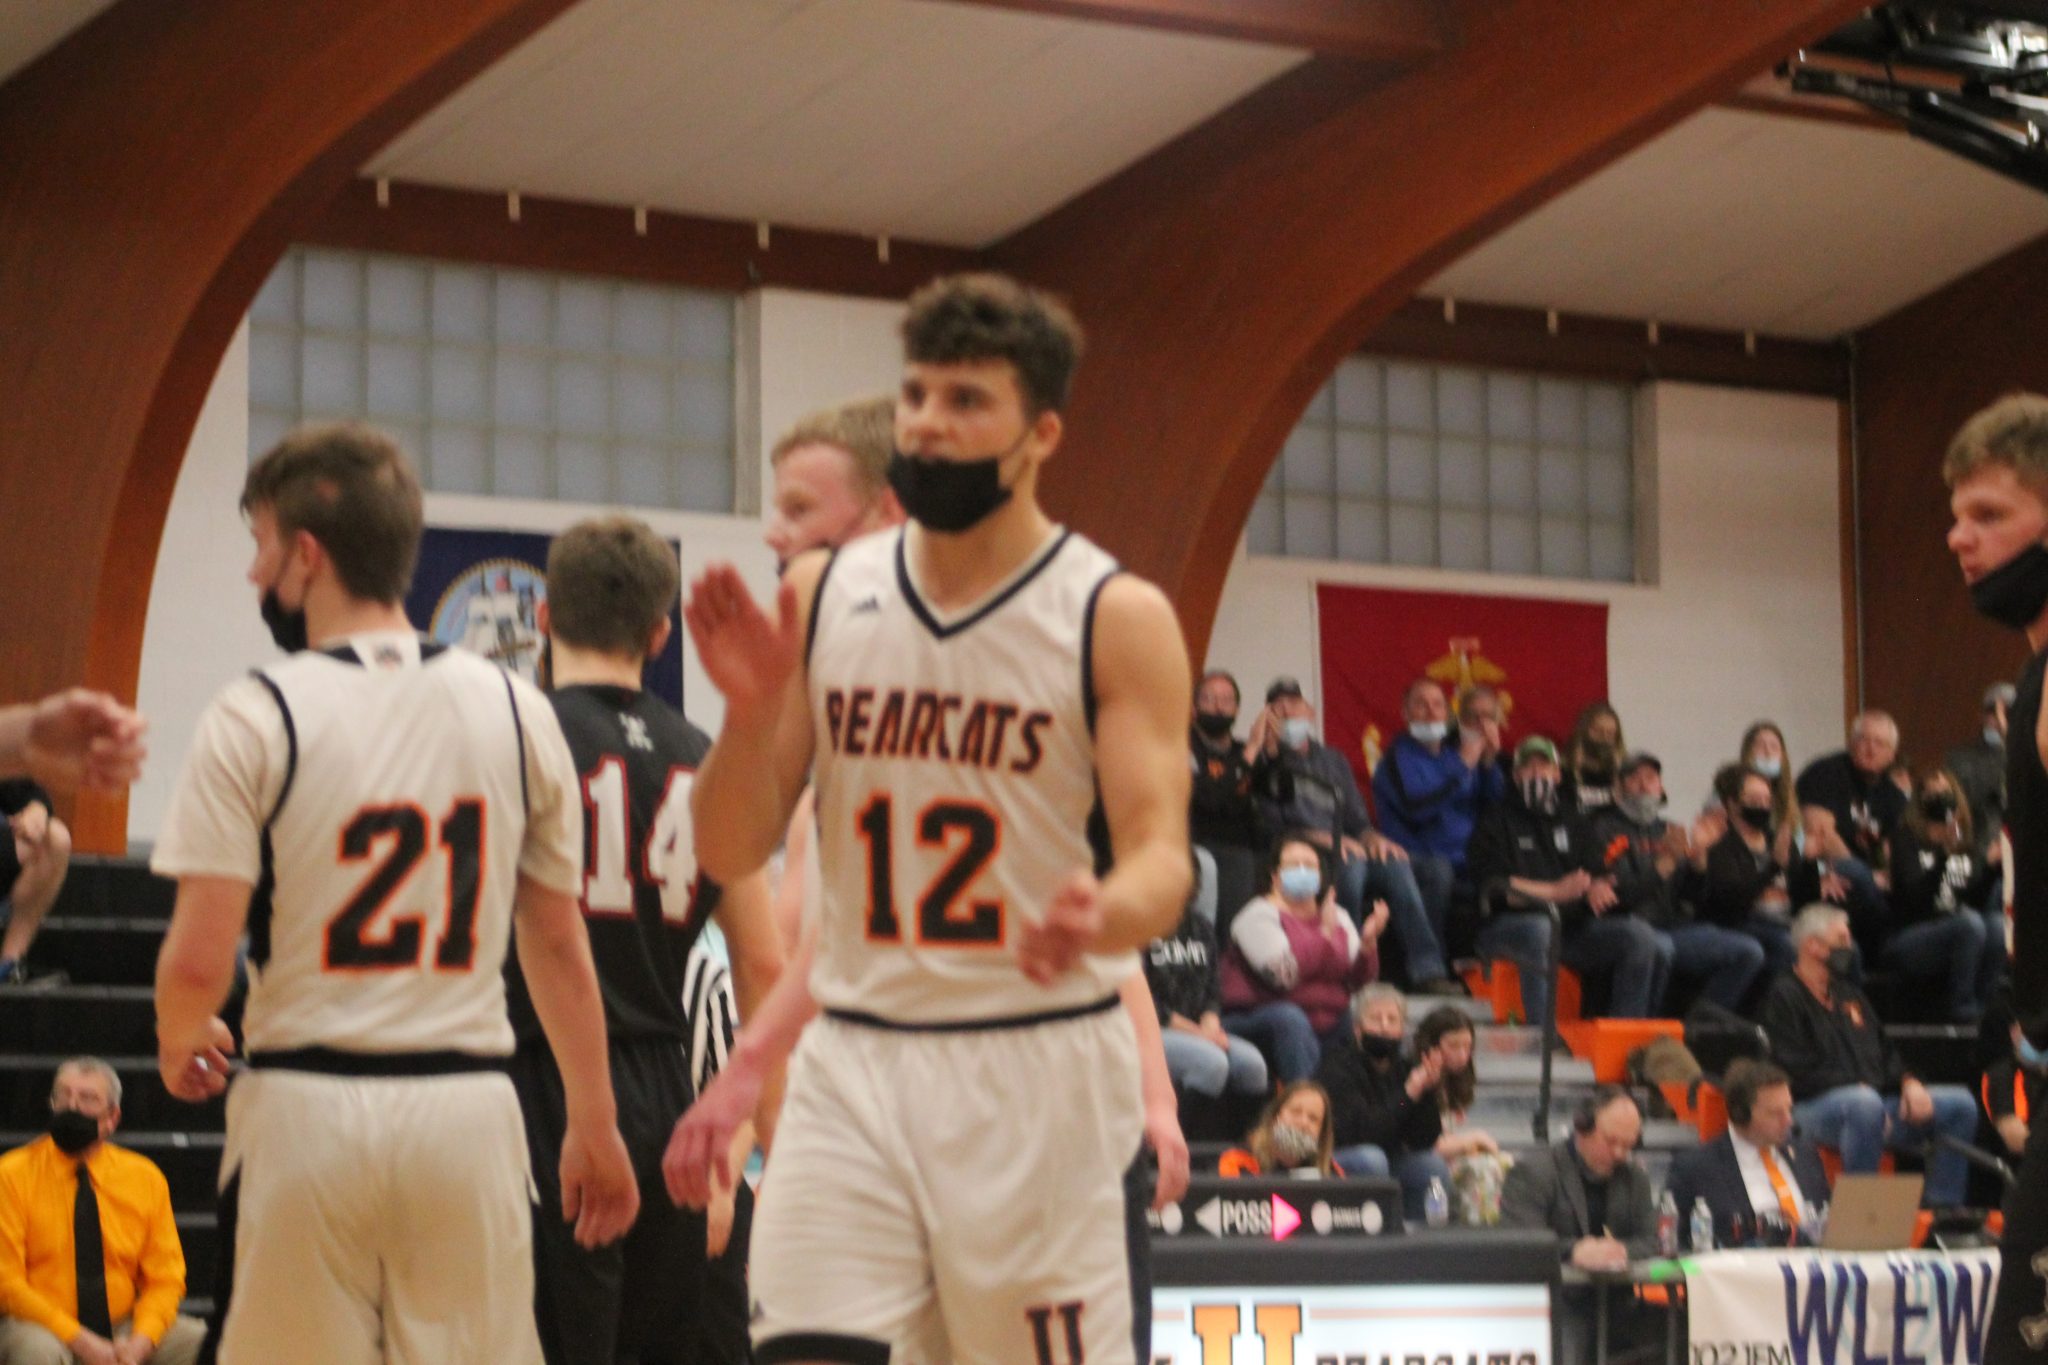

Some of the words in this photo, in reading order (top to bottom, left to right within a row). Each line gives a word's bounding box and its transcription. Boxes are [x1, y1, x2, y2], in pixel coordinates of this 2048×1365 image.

[825, 687, 1053, 774] BEARCATS
[322, 796, 487, 972] 21
[581, 754, 699, 927] 14
[854, 788, 1006, 949] 12
[1222, 1199, 1272, 1235] POSS
[1779, 1258, 1992, 1365] WLEW
